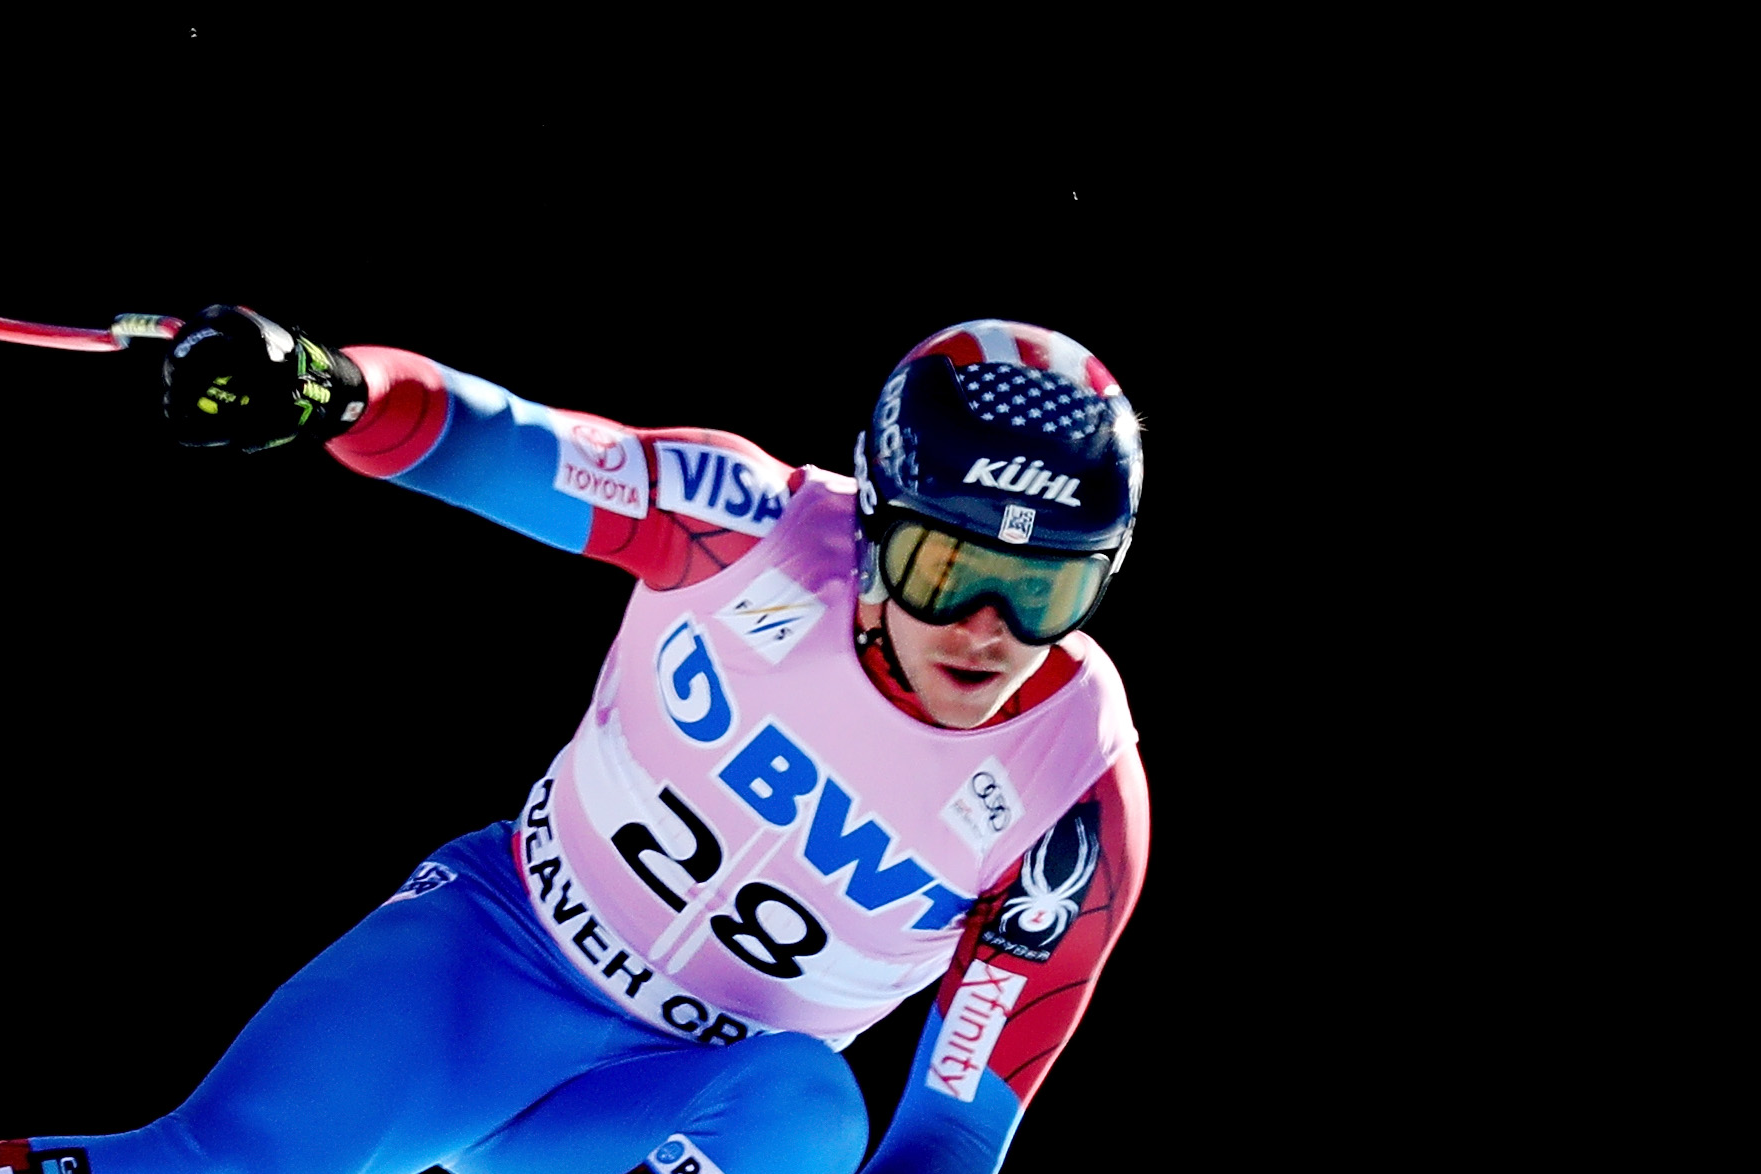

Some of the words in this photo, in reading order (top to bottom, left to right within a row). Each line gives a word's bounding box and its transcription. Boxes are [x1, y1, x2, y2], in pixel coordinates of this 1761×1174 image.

[564, 463, 639, 505] TOYOTA
[662, 447, 784, 523] VISA
[963, 456, 1081, 507] KÜHL
[611, 786, 829, 979] 28
